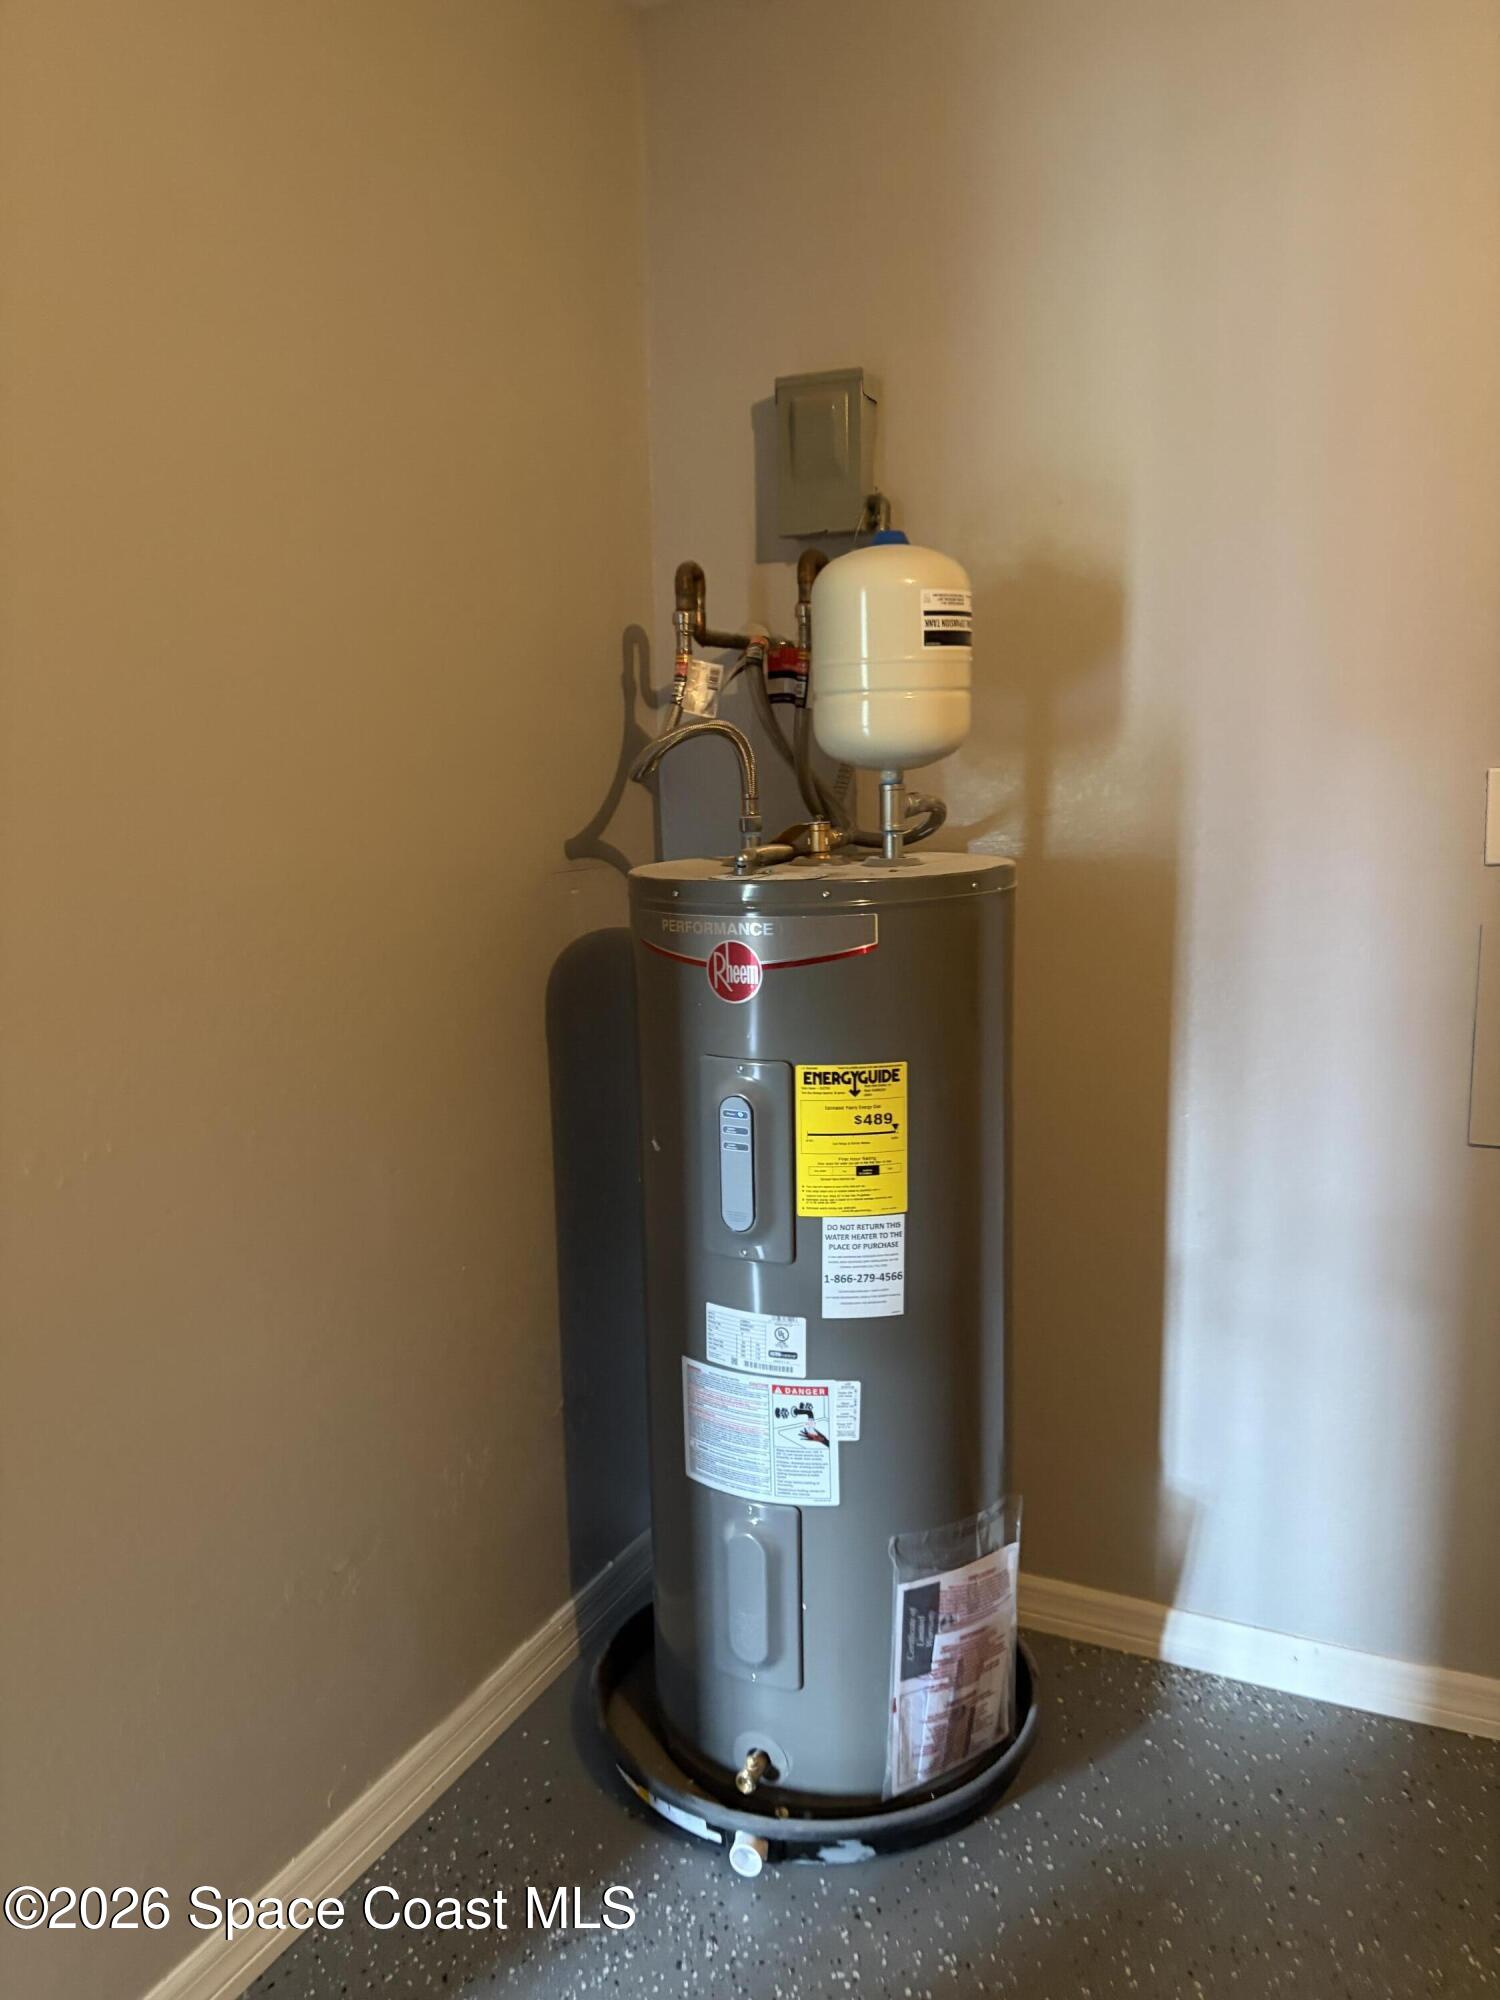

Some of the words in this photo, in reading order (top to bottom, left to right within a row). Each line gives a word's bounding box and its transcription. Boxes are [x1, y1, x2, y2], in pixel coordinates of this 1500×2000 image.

[661, 918, 774, 936] PERFORMANCE
[713, 943, 759, 992] Rheem
[804, 1069, 900, 1085] ENERGYGUIDE
[854, 1113, 892, 1125] $489
[856, 1222, 885, 1230] RETURN
[886, 1221, 901, 1229] THIS
[824, 1272, 902, 1283] 1-866-279-4566
[785, 1387, 825, 1395] DANGER
